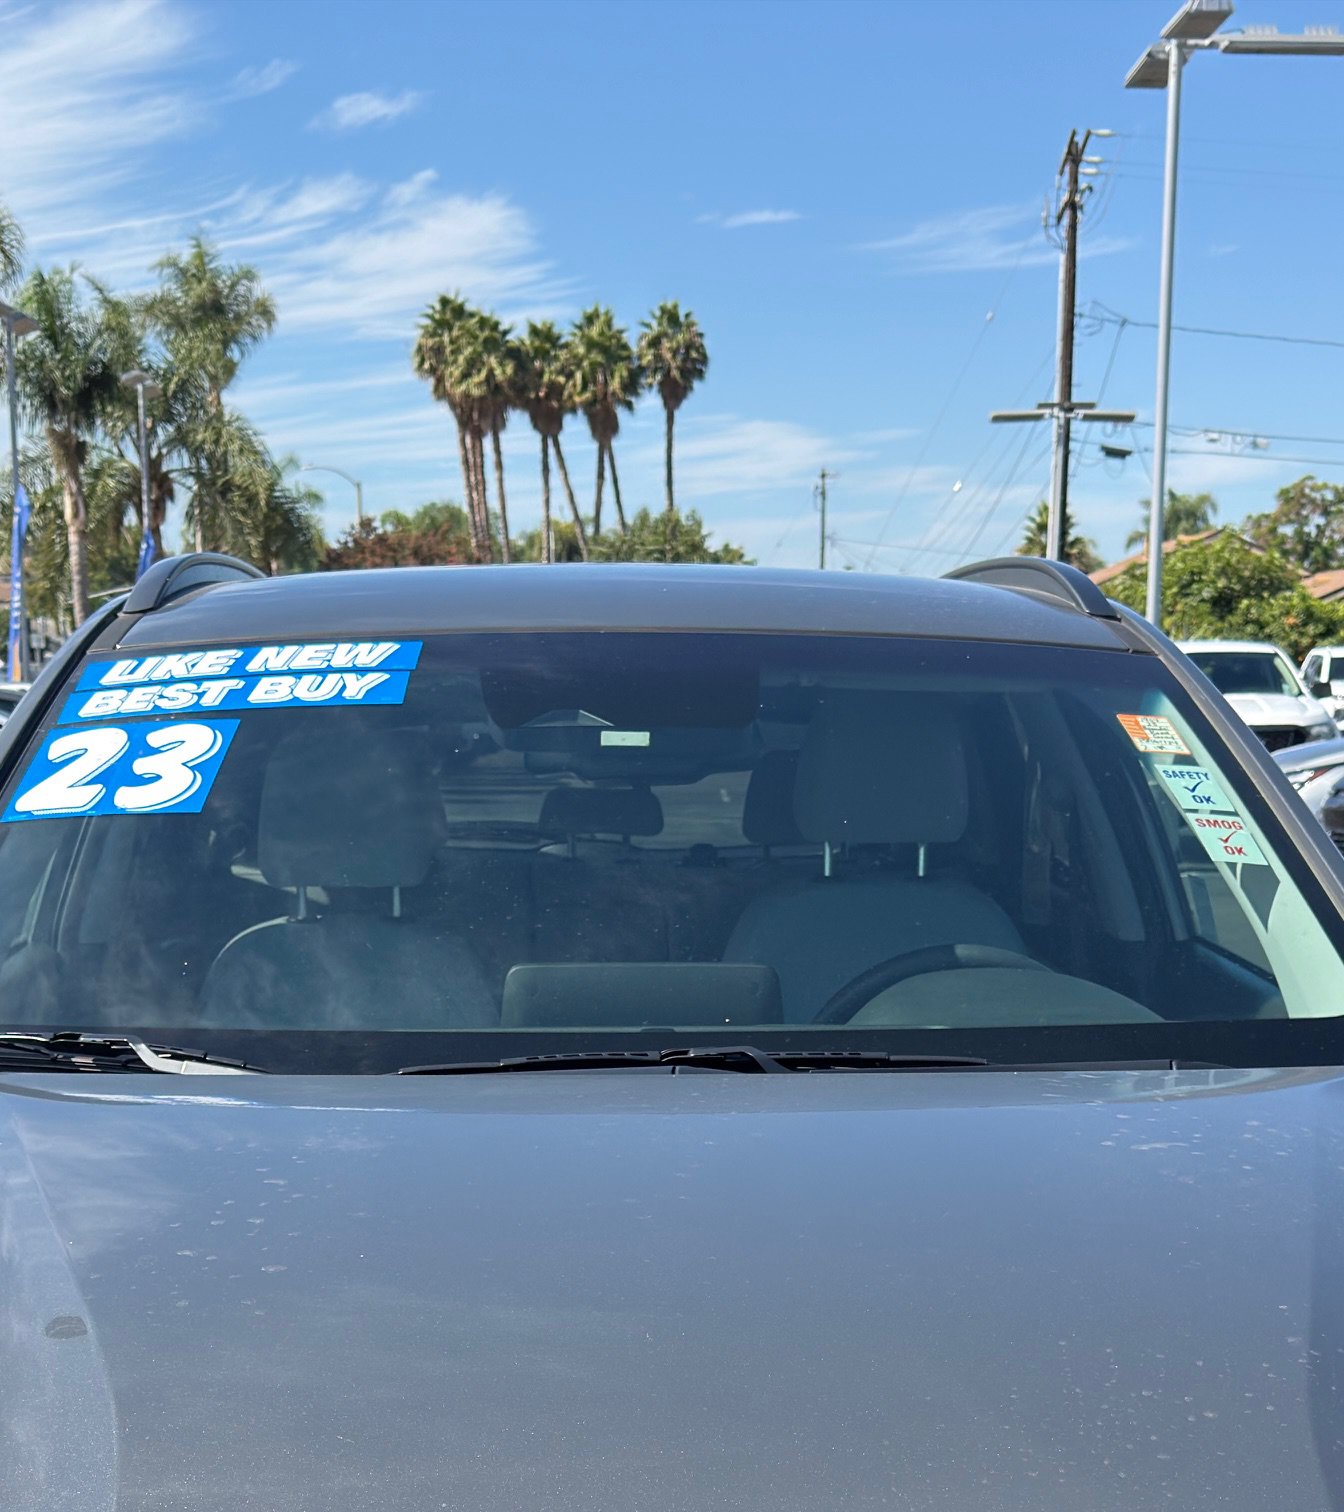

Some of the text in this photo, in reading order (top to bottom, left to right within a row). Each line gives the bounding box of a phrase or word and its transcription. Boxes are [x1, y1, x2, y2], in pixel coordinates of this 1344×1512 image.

[98, 641, 401, 687] LIKE NEW
[77, 671, 391, 718] BEST BUY
[14, 723, 223, 816] 23
[1162, 769, 1211, 781] SAFETY
[1191, 794, 1217, 805] OK
[1195, 818, 1244, 831] SMOG
[1223, 845, 1248, 857] OK
